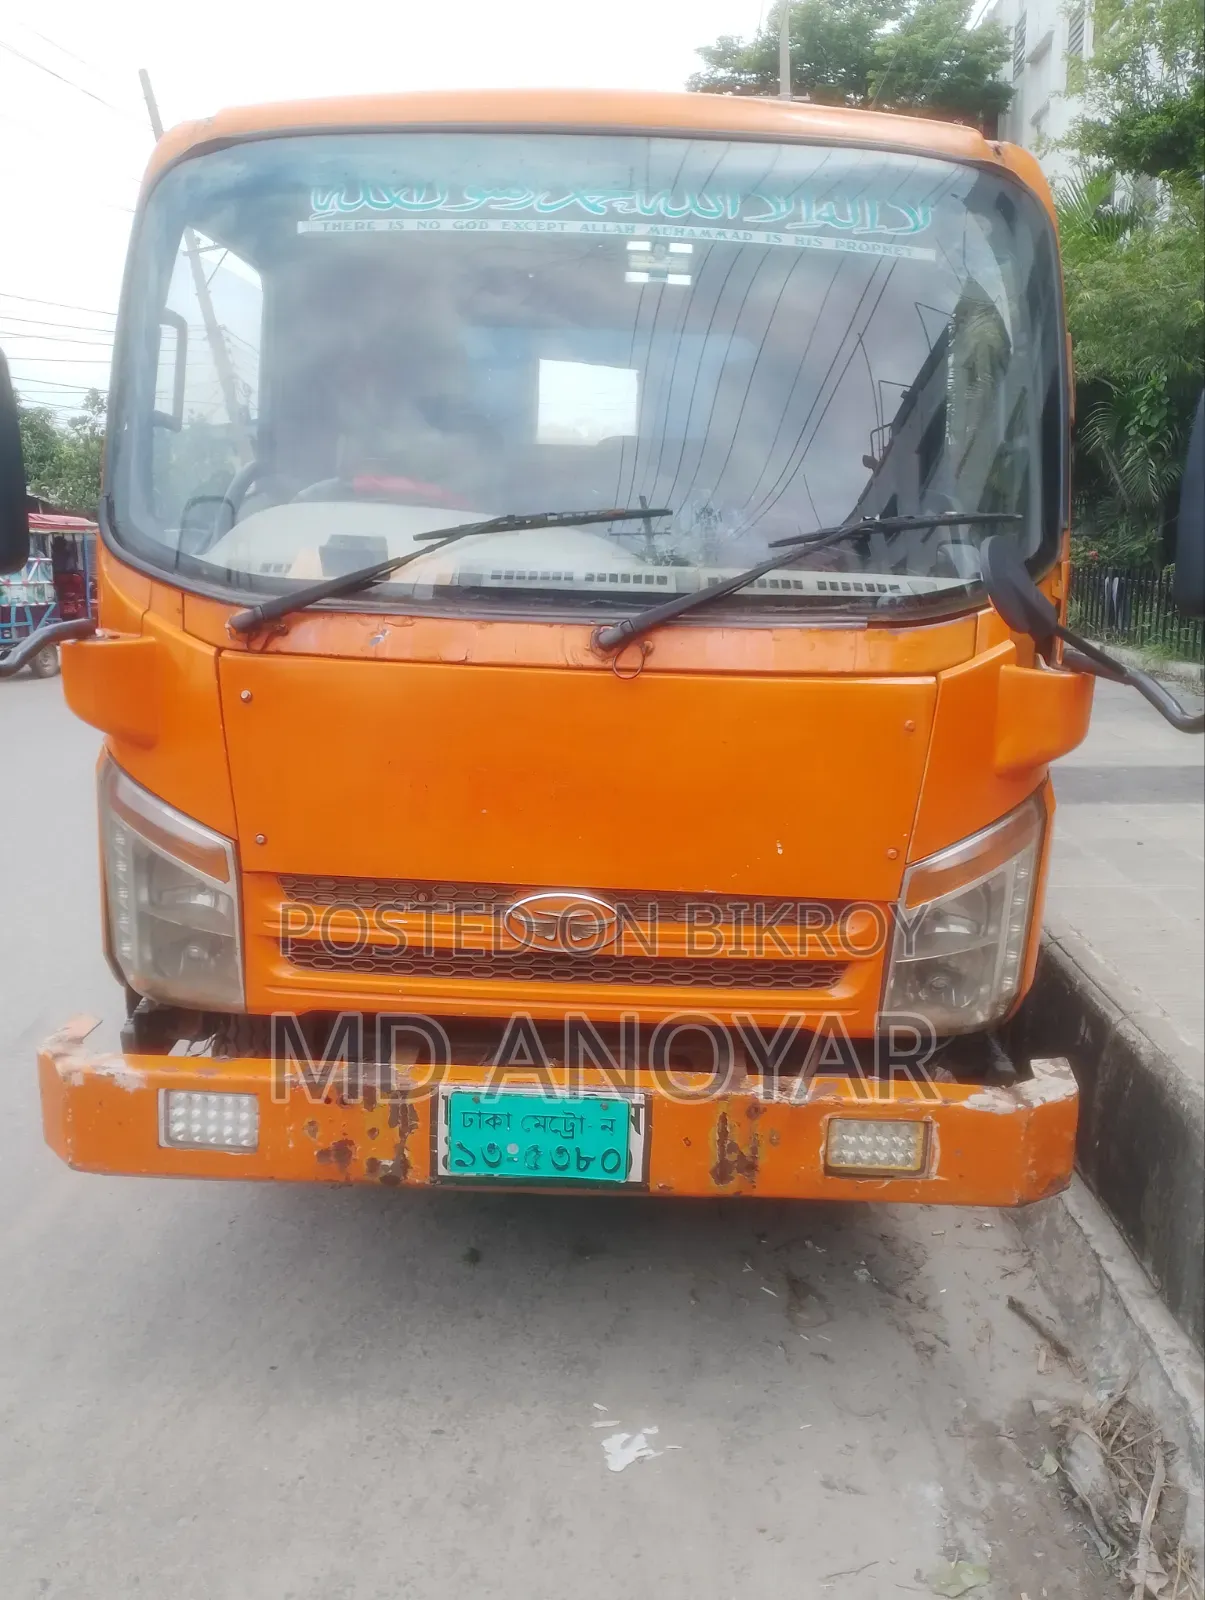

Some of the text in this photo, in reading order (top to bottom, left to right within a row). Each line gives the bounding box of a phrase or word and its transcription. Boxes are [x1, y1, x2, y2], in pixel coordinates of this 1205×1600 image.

[321, 221, 376, 231] THERE
[388, 220, 405, 230] IS
[416, 220, 441, 230] NO
[452, 219, 489, 231] GOD
[501, 220, 568, 232] EXCEPT
[579, 223, 636, 234] ALLAH
[647, 226, 753, 242] MUHAMMAD
[765, 233, 783, 245] IS
[794, 235, 824, 248] HIS
[460, 1110, 513, 1131] ঢাকা
